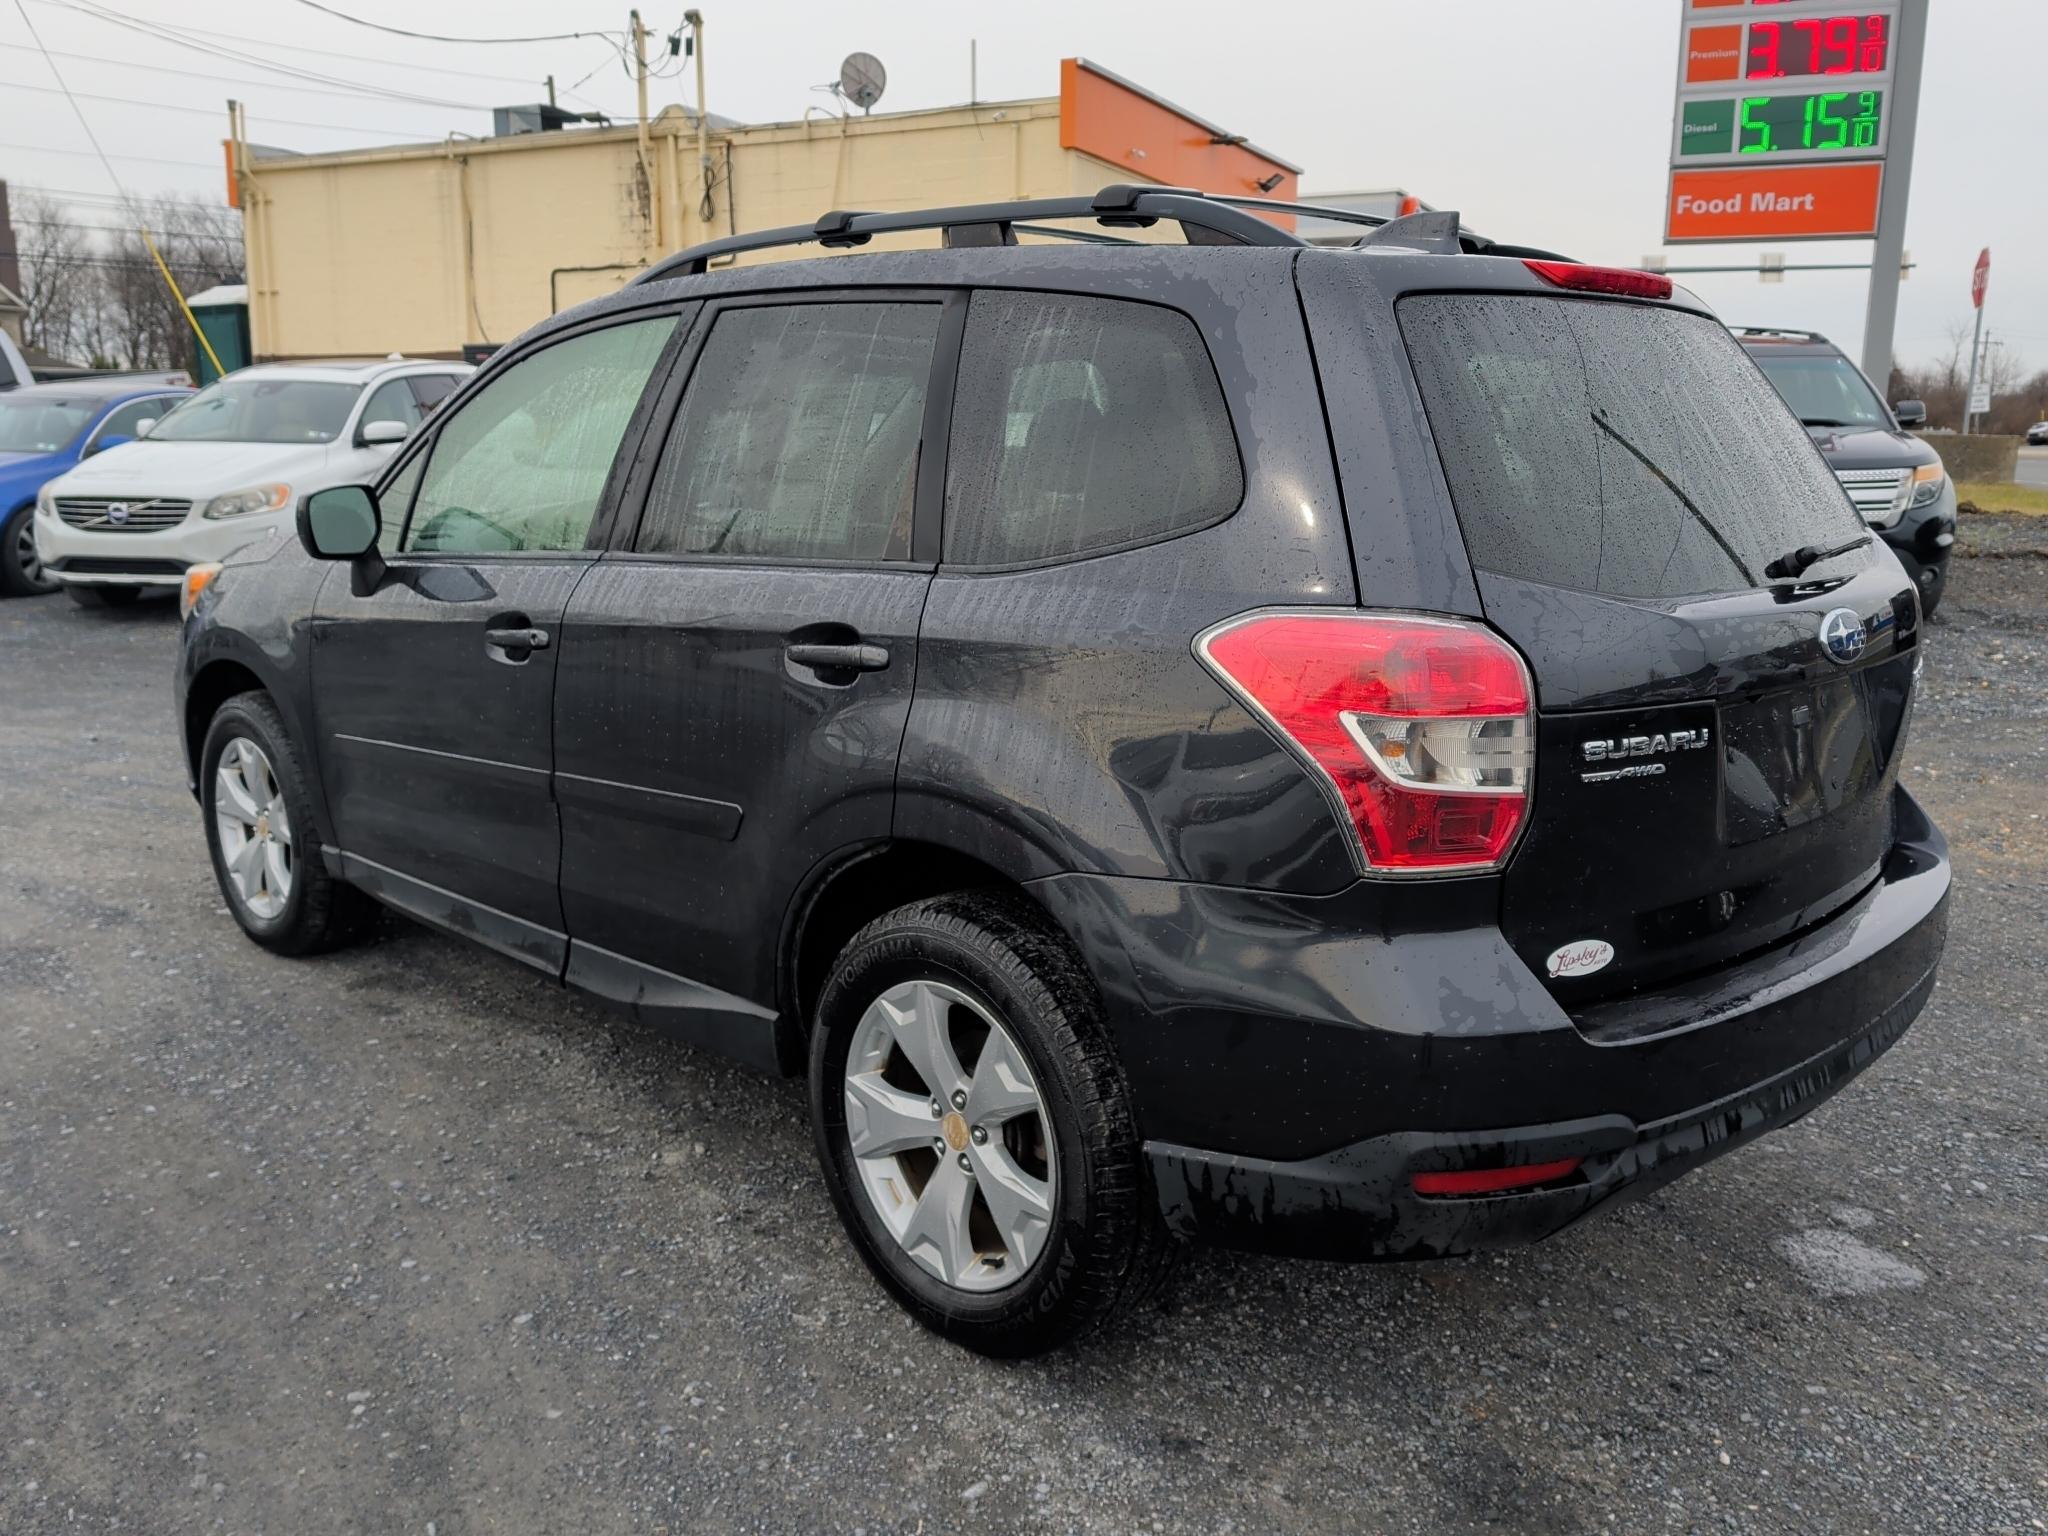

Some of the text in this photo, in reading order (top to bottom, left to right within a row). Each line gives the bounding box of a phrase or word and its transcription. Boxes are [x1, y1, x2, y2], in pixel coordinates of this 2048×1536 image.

[1690, 49, 1738, 59] Premium
[1747, 17, 1859, 80] 3.79
[1684, 123, 1718, 133] Diesel
[1740, 92, 1849, 154] 5.15
[1676, 192, 1815, 215] Food Mart
[1583, 728, 1709, 761] SUBARU
[1615, 763, 1667, 780] AWD
